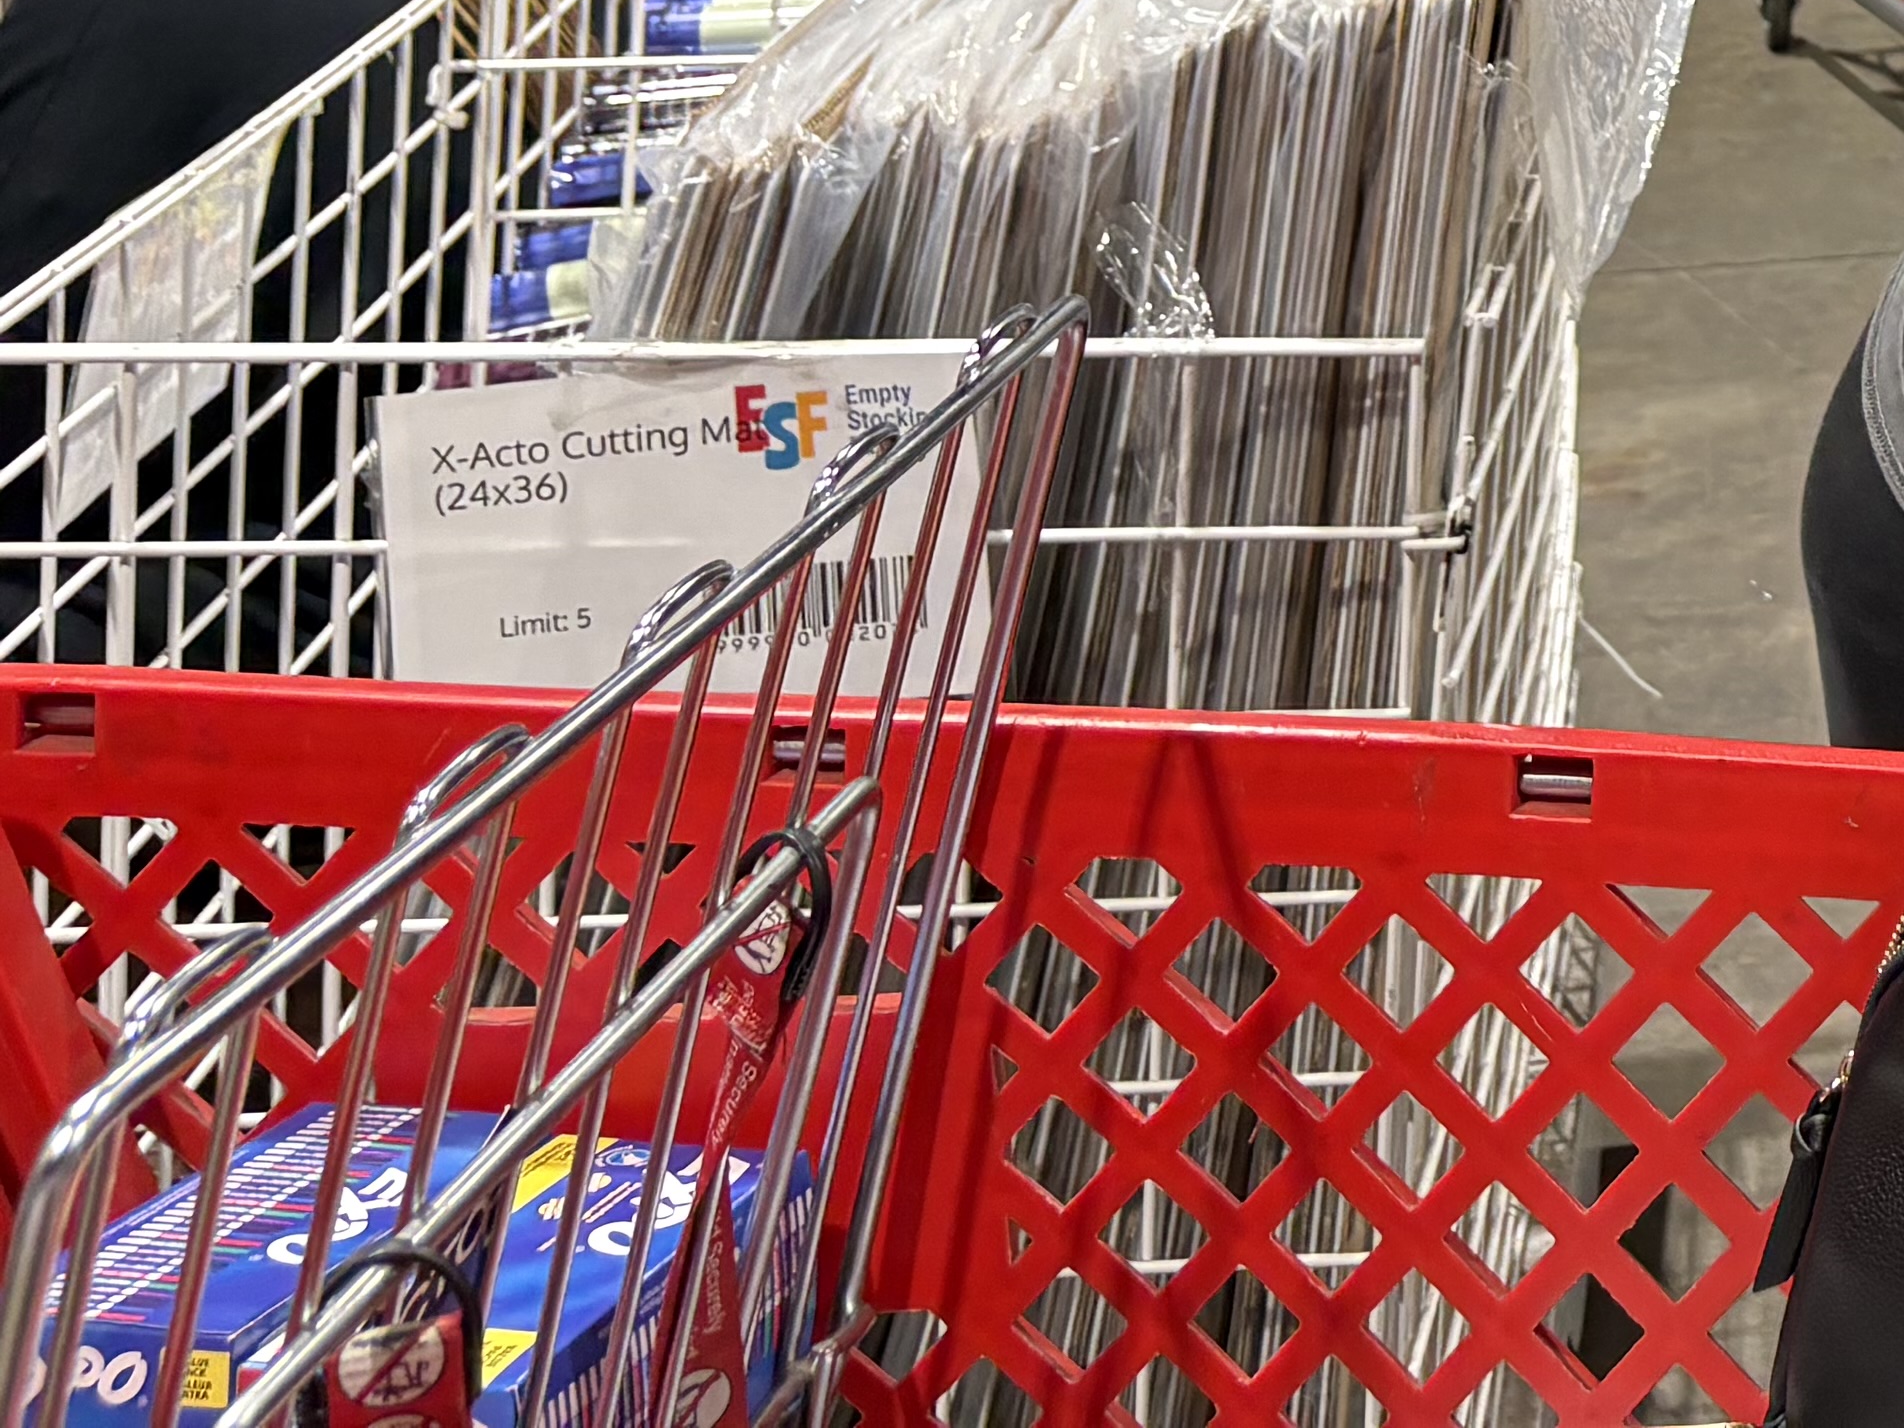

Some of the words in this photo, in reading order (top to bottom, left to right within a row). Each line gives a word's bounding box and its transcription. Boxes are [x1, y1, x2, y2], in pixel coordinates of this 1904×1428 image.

[845, 384, 911, 407] Empty
[431, 441, 550, 475] X-Acto
[561, 423, 690, 466] Cutting
[734, 384, 828, 470] ESF
[434, 471, 569, 518] (24x36)
[499, 613, 569, 640] Limit:
[576, 607, 593, 631] 5
